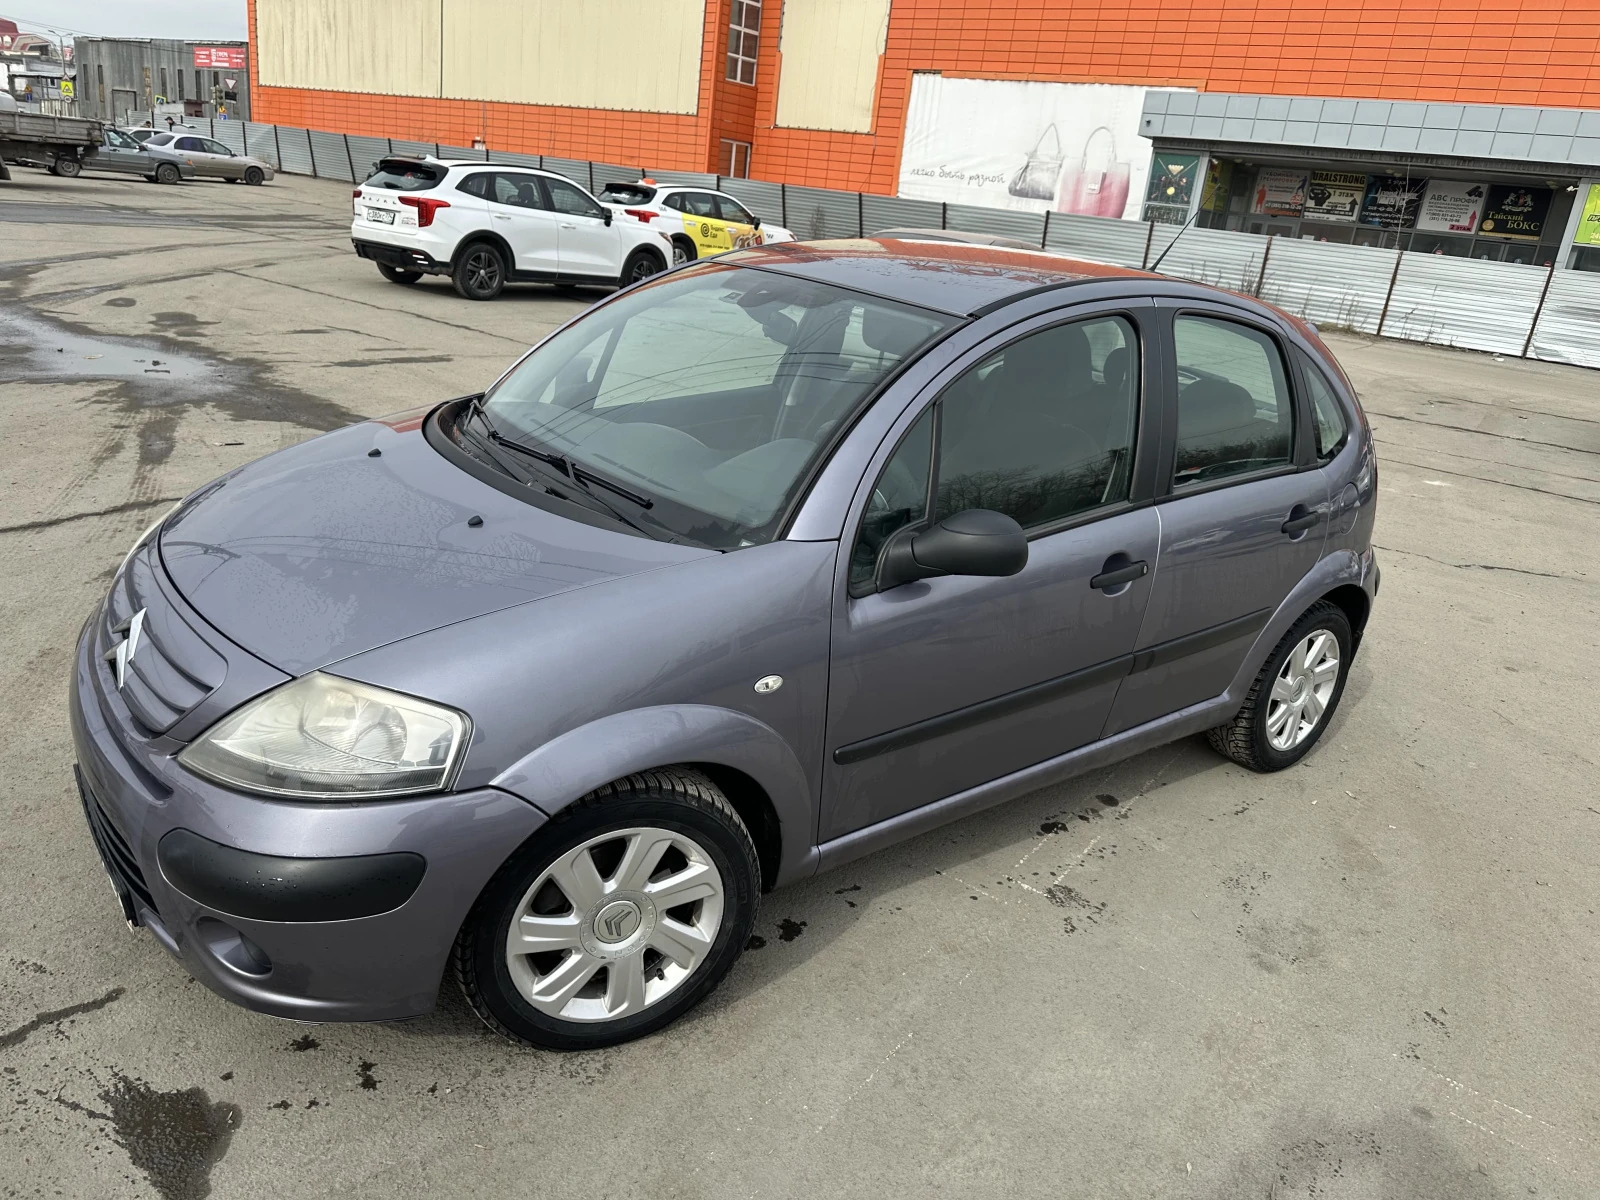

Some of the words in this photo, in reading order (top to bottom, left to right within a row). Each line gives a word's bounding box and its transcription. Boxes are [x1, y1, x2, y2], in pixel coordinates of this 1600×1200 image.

[910, 168, 936, 178] легко
[938, 164, 965, 180] быть
[967, 173, 1006, 187] разной
[1312, 171, 1366, 185] URALSTRONG
[1450, 196, 1478, 205] ПРОФИ
[1488, 211, 1524, 221] Тайский
[1506, 220, 1540, 231] БОКС
